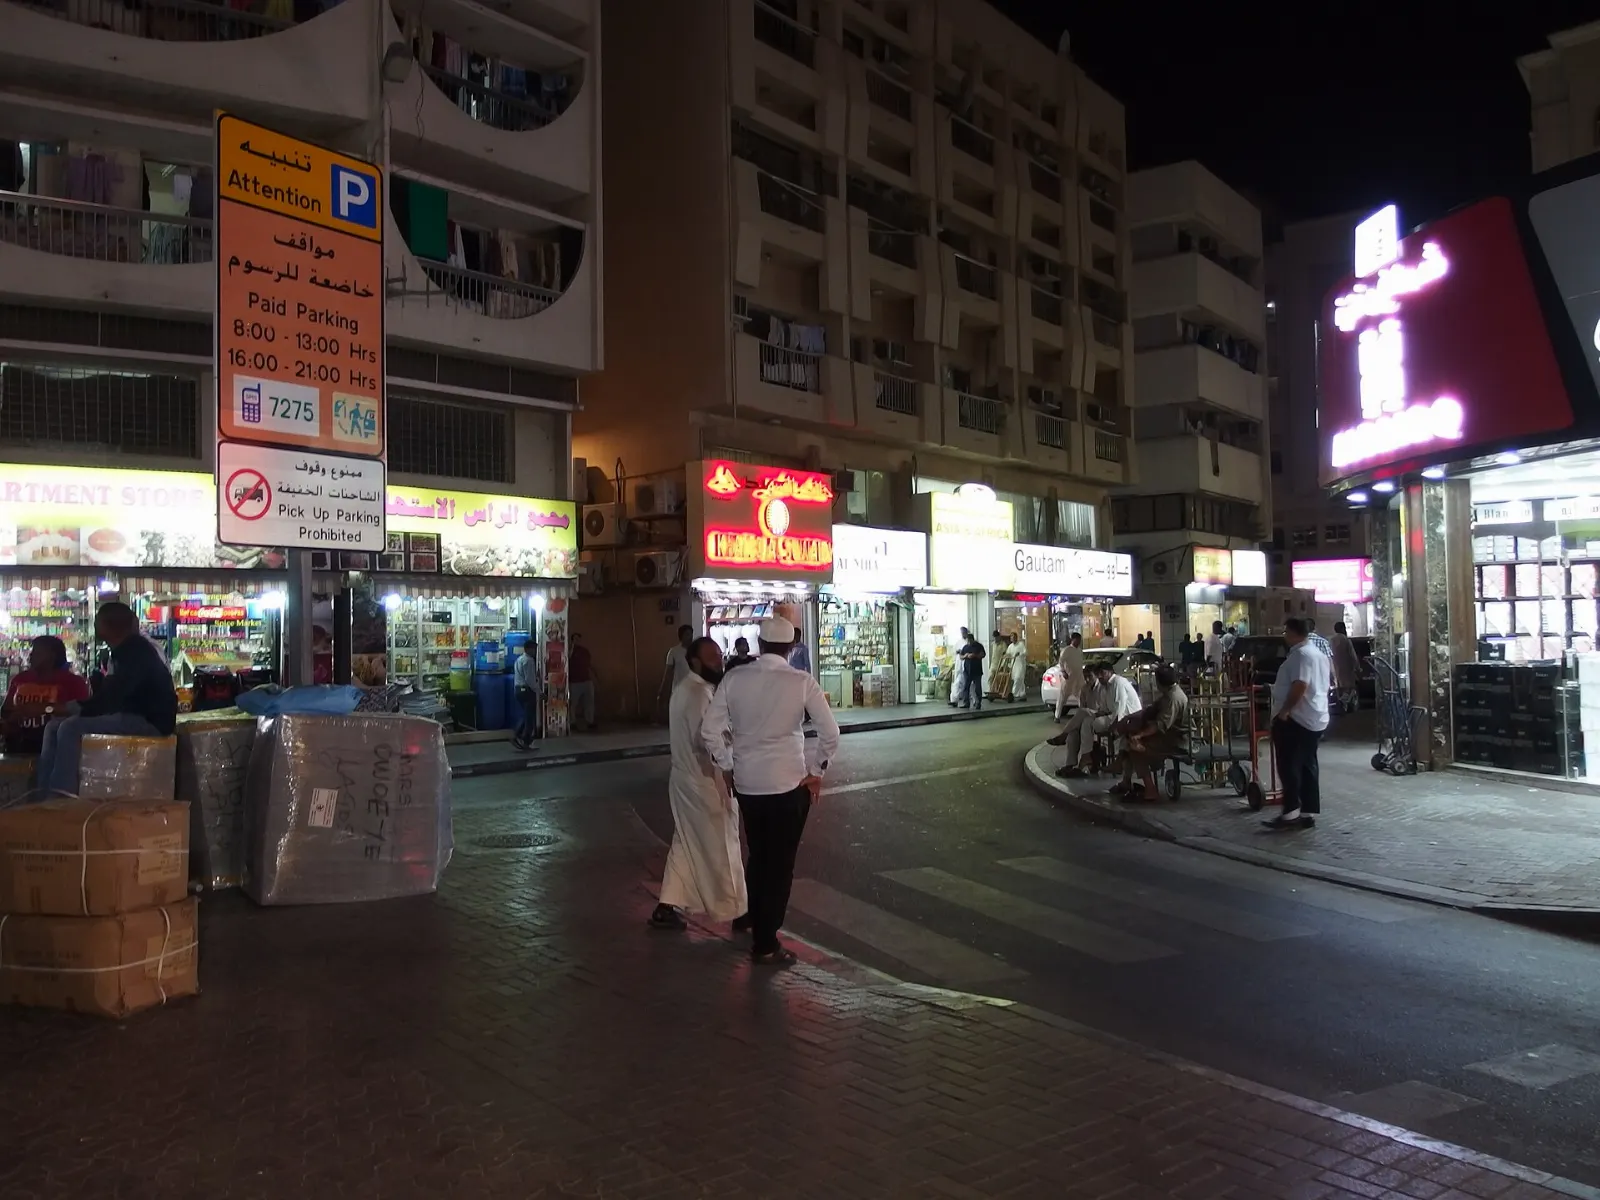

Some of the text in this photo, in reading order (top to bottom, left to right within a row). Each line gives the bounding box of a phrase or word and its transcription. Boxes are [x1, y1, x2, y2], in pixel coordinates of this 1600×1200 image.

[239, 140, 312, 173] تنبيه
[227, 169, 321, 213] Attention
[339, 170, 370, 217] P
[273, 231, 335, 259] مواقف
[228, 255, 374, 298] خاضعة للرسوم
[248, 291, 359, 335] Paid Parking
[233, 319, 275, 342] 8:00
[295, 332, 340, 356] 13:00
[349, 342, 377, 363] Hrs
[228, 347, 278, 372] 16:00
[294, 360, 341, 384] 21:00
[349, 369, 377, 390] Hrs
[268, 396, 314, 422] 7275
[295, 459, 362, 480] ممنوع وقوف
[0, 481, 205, 509] RTMENT STORE
[277, 481, 380, 502] الشاحنات الخفيفة
[278, 504, 381, 527] Pick Up Parking
[299, 526, 362, 543] Prohibited
[1014, 549, 1066, 574] Gautam
[214, 618, 262, 627] Spice Market
